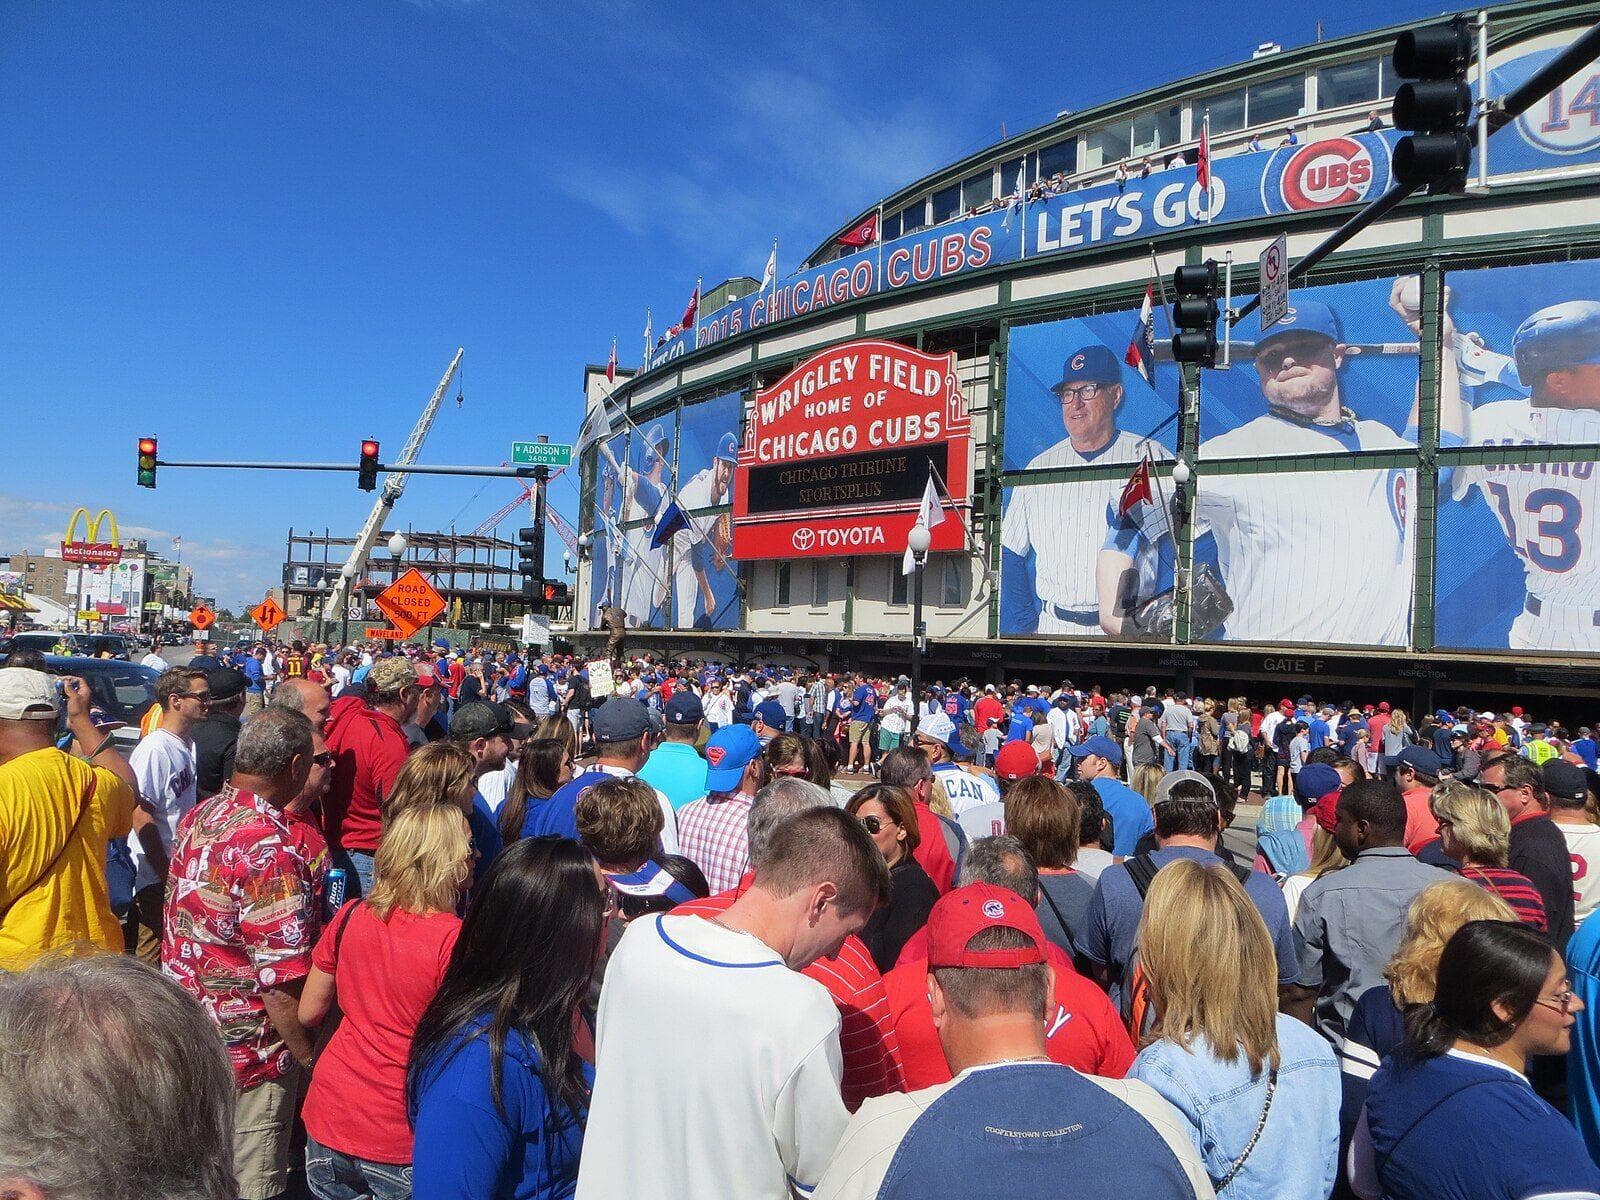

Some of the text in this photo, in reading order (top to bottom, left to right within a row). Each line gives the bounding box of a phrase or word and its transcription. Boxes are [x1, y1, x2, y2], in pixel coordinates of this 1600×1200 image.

[1037, 176, 1226, 253] LET'S GO
[699, 226, 992, 347] 2015 CHICAGO CUBS
[761, 354, 941, 426] WRIGLEY FIELD
[805, 390, 887, 418] HOME OF
[759, 411, 940, 462] CHICAGO CUBS
[523, 446, 560, 455] ADDISON
[779, 457, 907, 485] CHICAGO TRIBUNE
[800, 482, 882, 502] SPORTSPLUS
[1486, 480, 1582, 573] 13
[818, 527, 885, 546] TOYOTA
[64, 547, 118, 557] McDonald's
[398, 584, 426, 594] ROAD
[391, 597, 431, 607] CLOSED
[394, 610, 428, 619] 500 FT
[288, 661, 302, 676] 11
[1159, 659, 1199, 667] INSPECTION
[1264, 658, 1325, 673] GATE F
[1413, 662, 1432, 670] BAG
[1398, 669, 1447, 678] INSPECTION
[329, 881, 338, 905] BUD
[985, 1122, 1083, 1138] COOPERSTOWN COLLECTION
